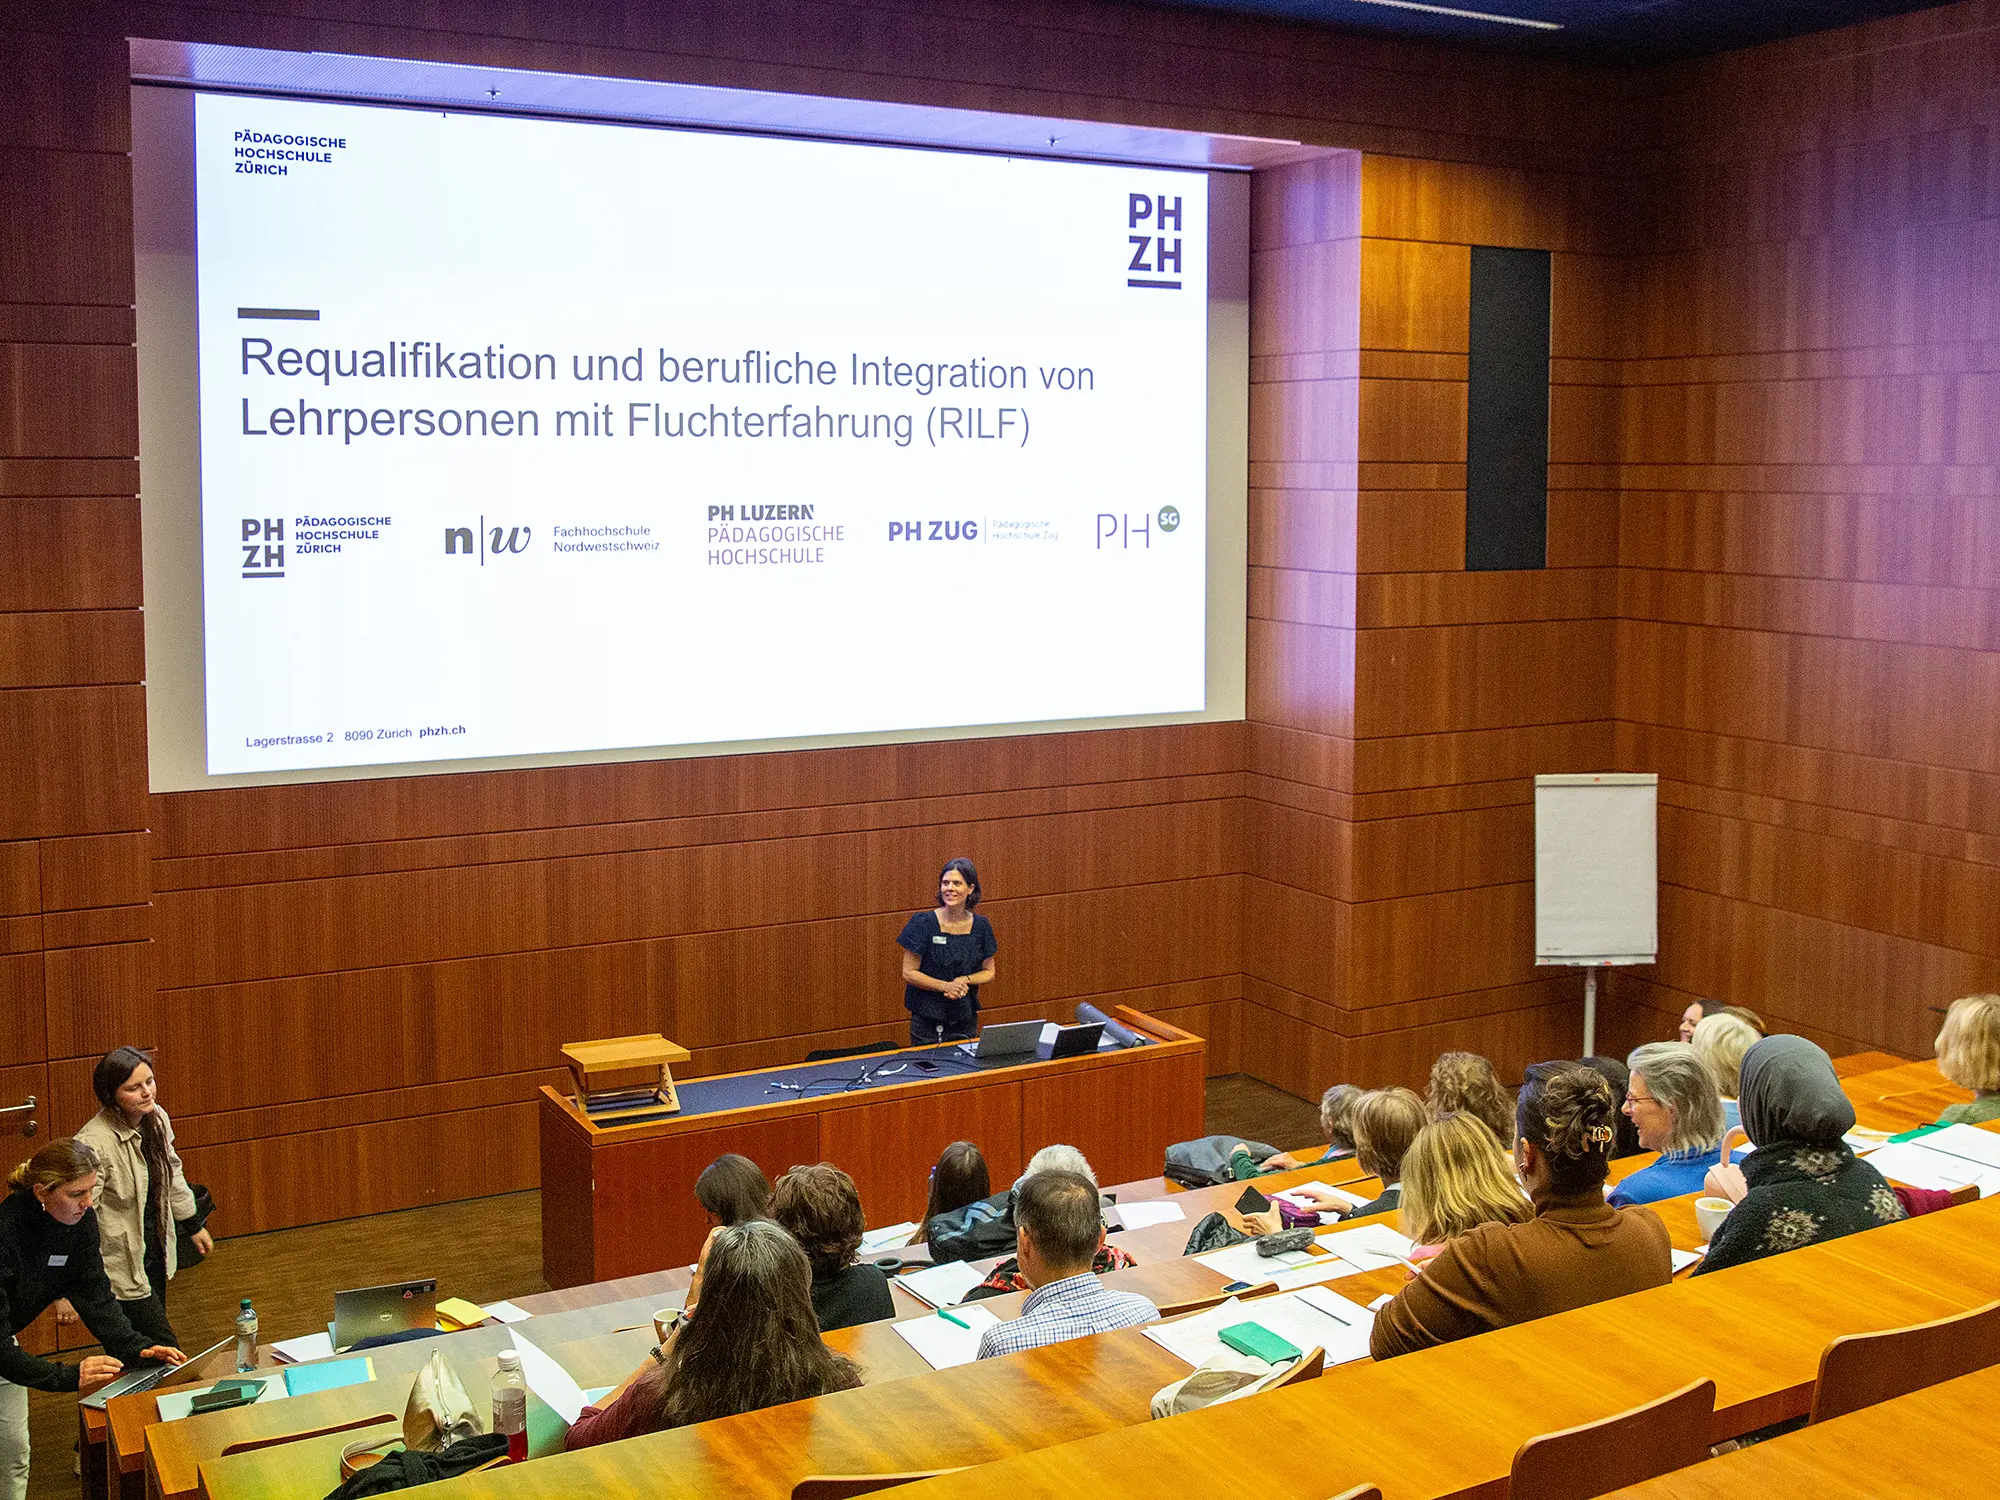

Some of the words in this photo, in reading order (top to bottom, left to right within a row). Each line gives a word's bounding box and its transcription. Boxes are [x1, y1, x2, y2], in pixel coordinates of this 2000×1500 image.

[234, 129, 346, 149] PÄDAGOGISCHE
[234, 147, 333, 163] HOCHSCHULE
[234, 161, 288, 176] ZÜRICH
[1128, 193, 1182, 231] PH
[1128, 235, 1182, 273] ZH
[241, 337, 556, 386] Requalifikation
[573, 348, 643, 382] und
[659, 347, 837, 386] berufliche
[852, 353, 1027, 396] Integration
[1040, 366, 1094, 391] von
[241, 397, 539, 446] Lehrpersonen
[556, 402, 614, 437] mit
[628, 402, 913, 447] Fluchterfahrung
[927, 406, 1030, 448] (RILF)
[295, 515, 392, 528] PÄDAGOGISCHE
[707, 504, 735, 522] PH
[740, 503, 815, 521] LUZERN
[242, 518, 285, 541] PH
[295, 529, 380, 541] HOCHSCHULE
[553, 525, 651, 538] Fachhochschule
[708, 523, 845, 544] PÄDAGOGISCHE
[888, 520, 922, 542] PH
[928, 520, 978, 541] ZUG
[1096, 513, 1150, 550] PH
[1159, 512, 1179, 526] SG
[242, 545, 285, 568] ZH
[295, 541, 342, 554] ZÜRICH
[553, 541, 660, 553] Nordwestschweiz
[708, 547, 825, 566] HOCHSCHULE
[245, 734, 323, 749] Lagerstrasse
[326, 731, 334, 743] 2
[344, 729, 374, 742] 8090
[376, 727, 413, 740] Zürich
[419, 724, 467, 739] phzh.ch
